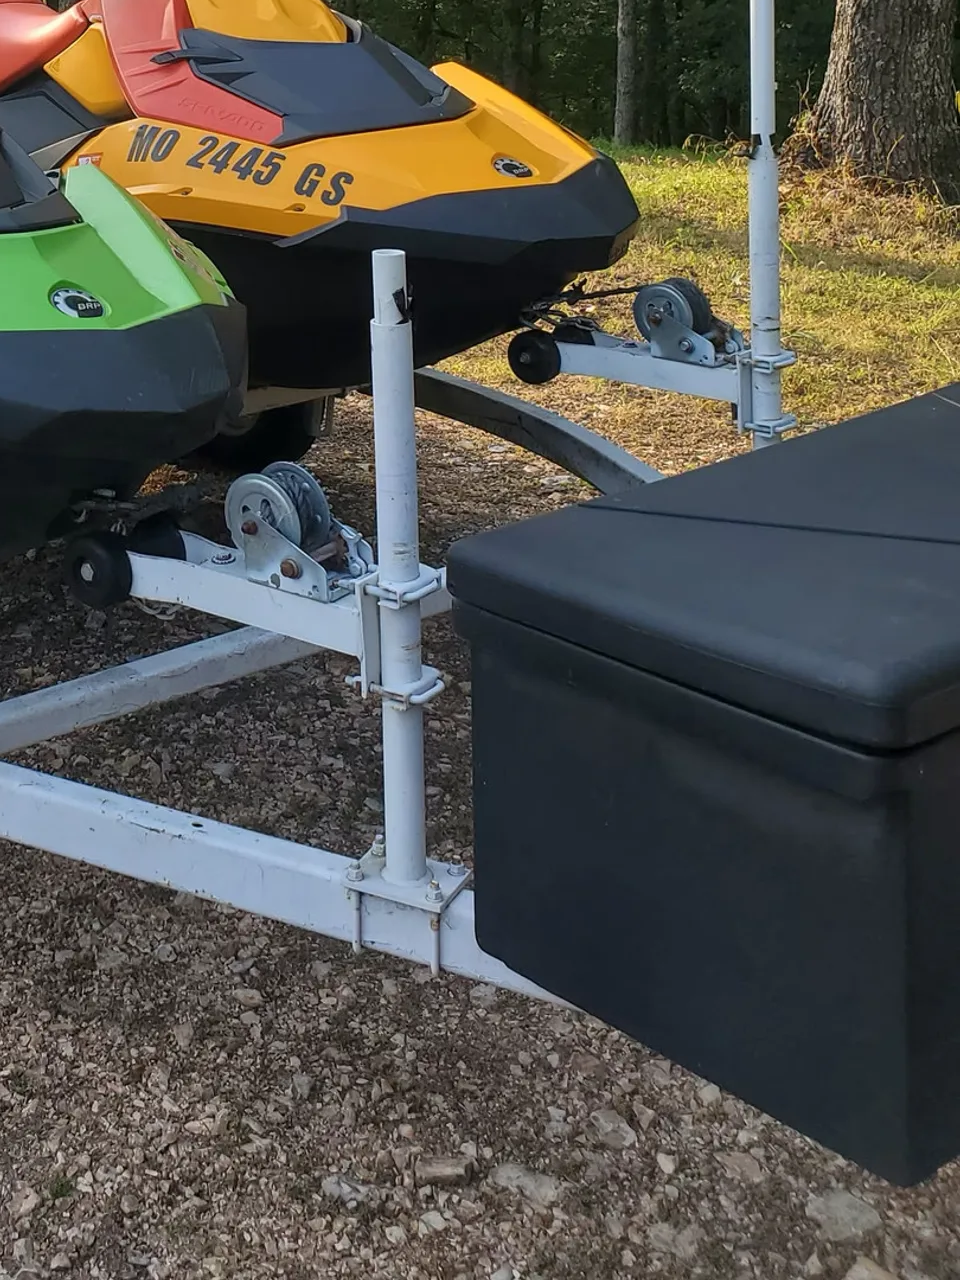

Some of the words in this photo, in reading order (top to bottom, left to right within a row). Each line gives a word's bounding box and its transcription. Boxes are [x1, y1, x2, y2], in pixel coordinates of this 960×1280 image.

[126, 124, 180, 162] MO
[185, 135, 286, 185] 2445
[294, 162, 354, 207] GS
[77, 302, 101, 311] BRP
